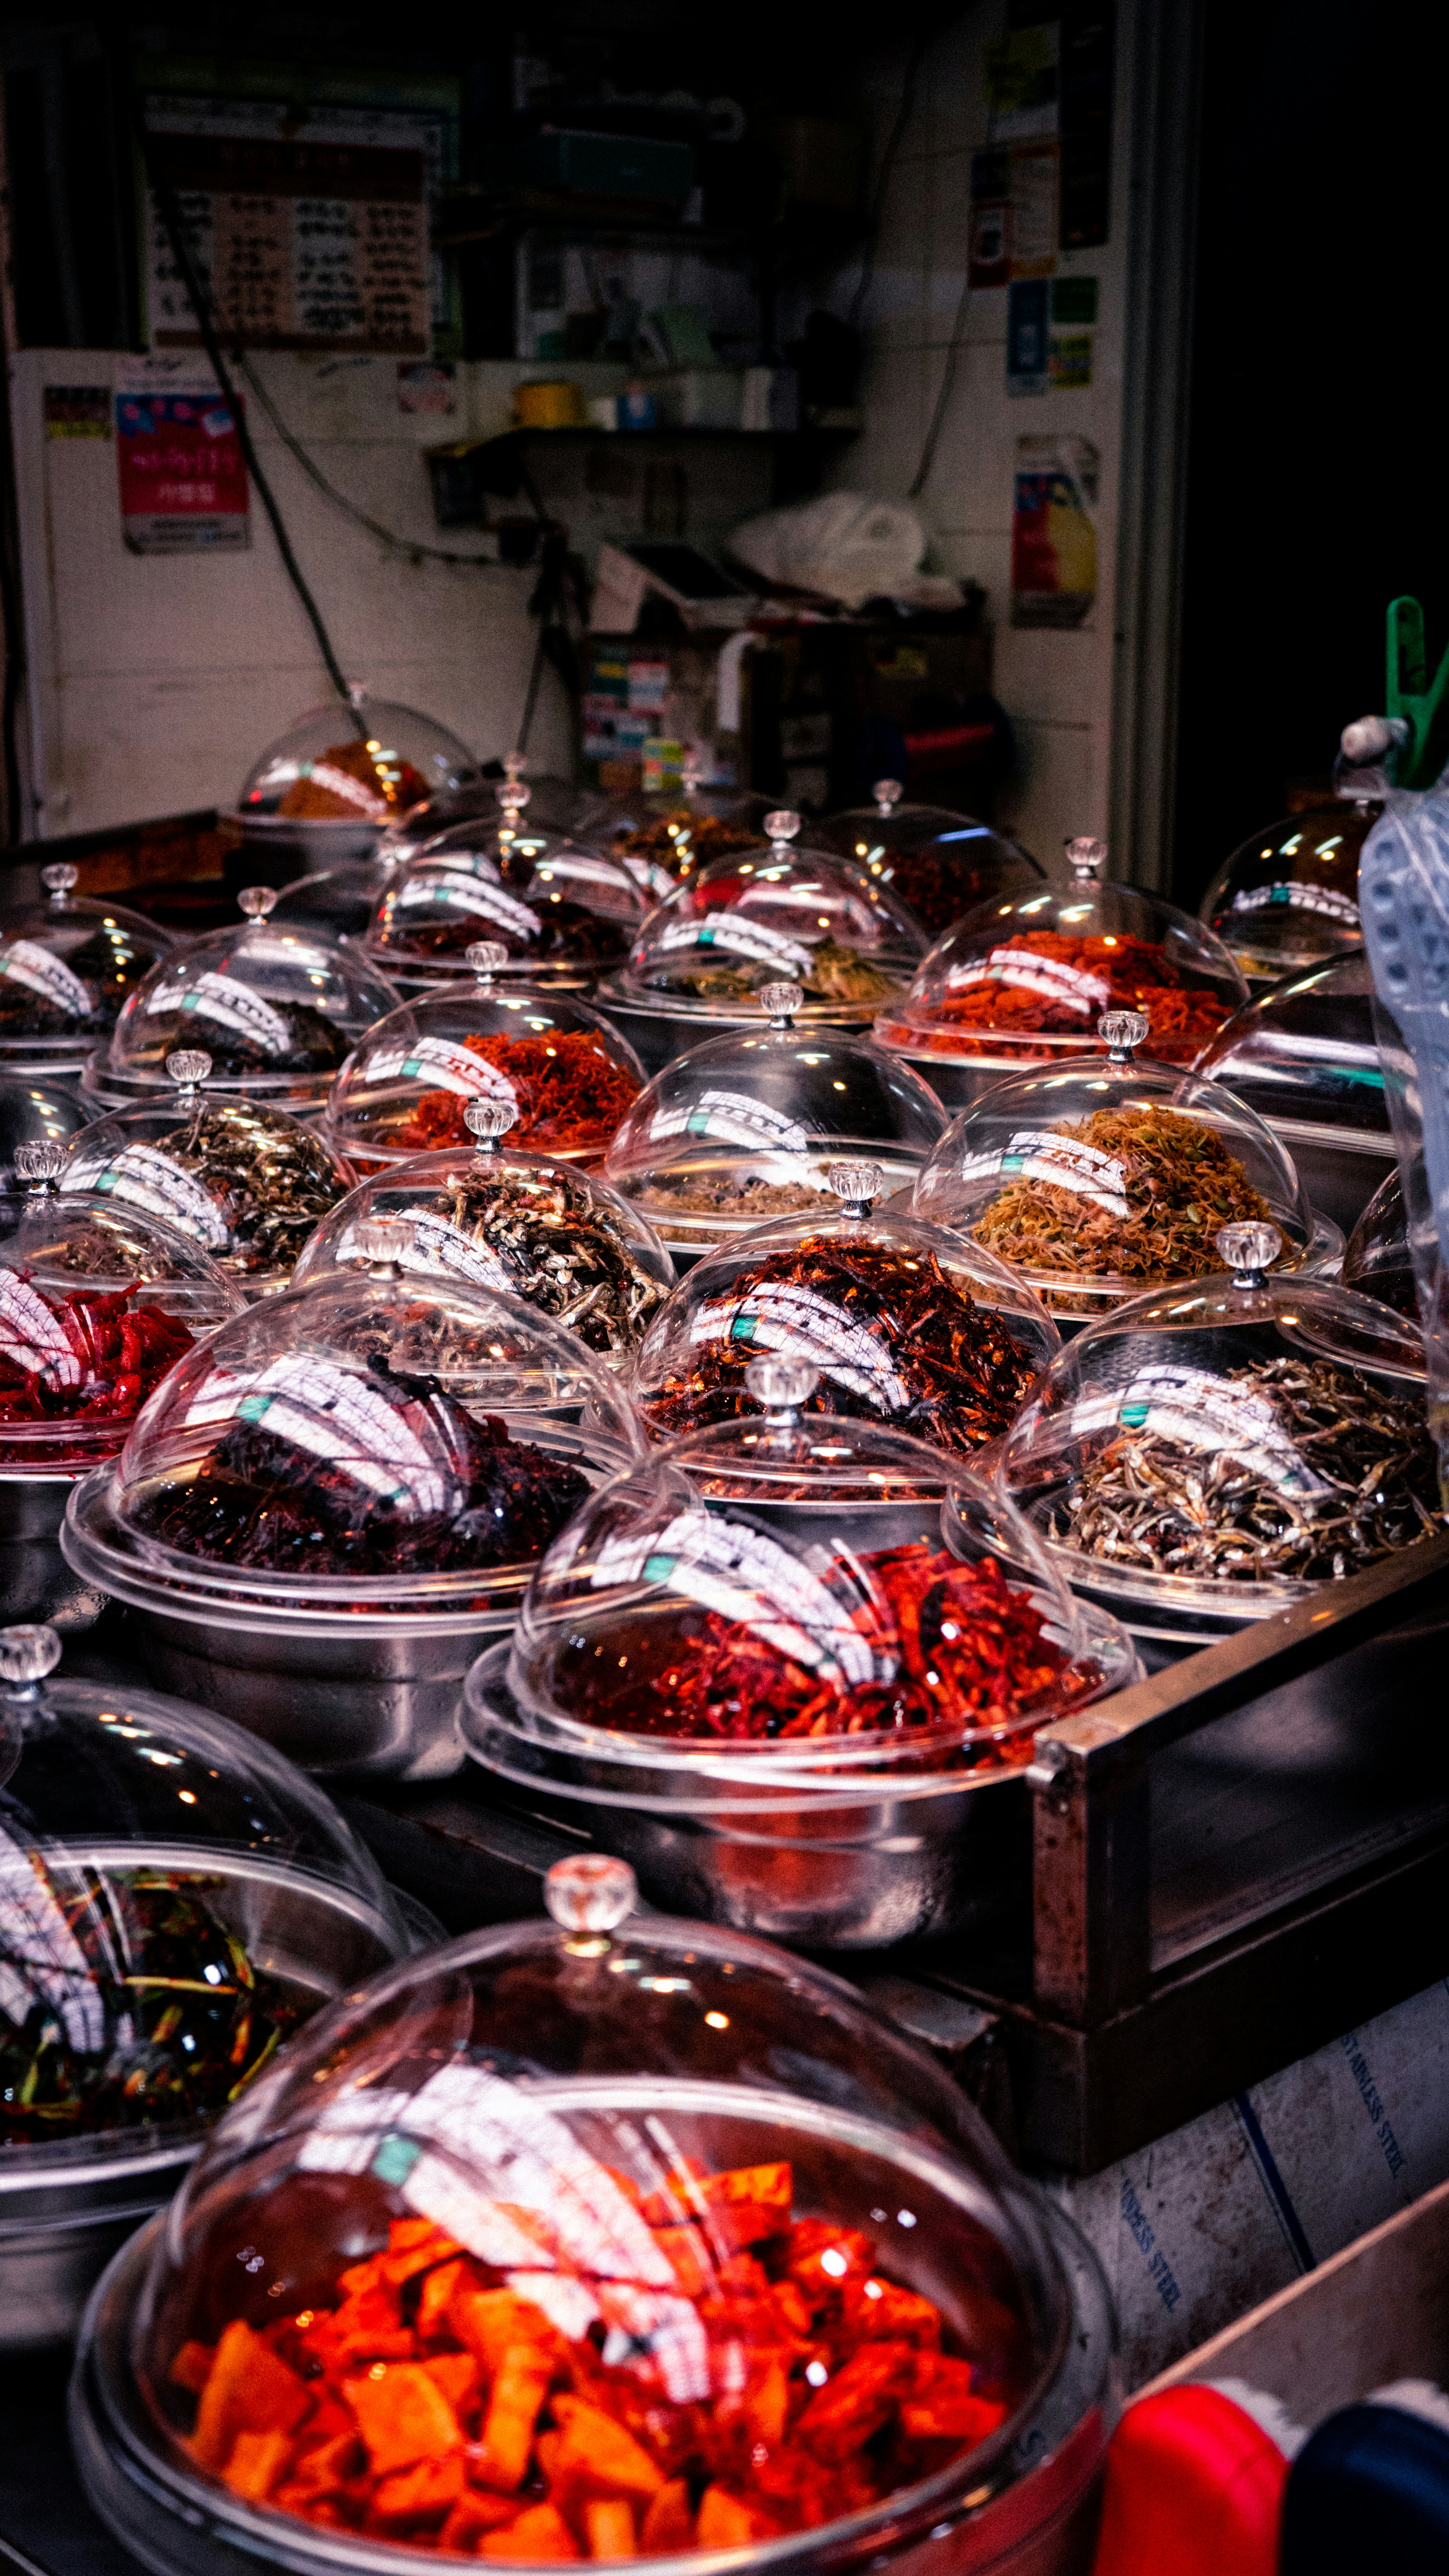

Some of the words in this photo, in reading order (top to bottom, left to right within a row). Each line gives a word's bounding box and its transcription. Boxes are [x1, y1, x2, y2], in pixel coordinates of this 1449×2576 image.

[1340, 2031, 1385, 2124] STAINLESS
[1377, 2120, 1405, 2179] STEEL
[1148, 2251, 1180, 2314] STEEL
